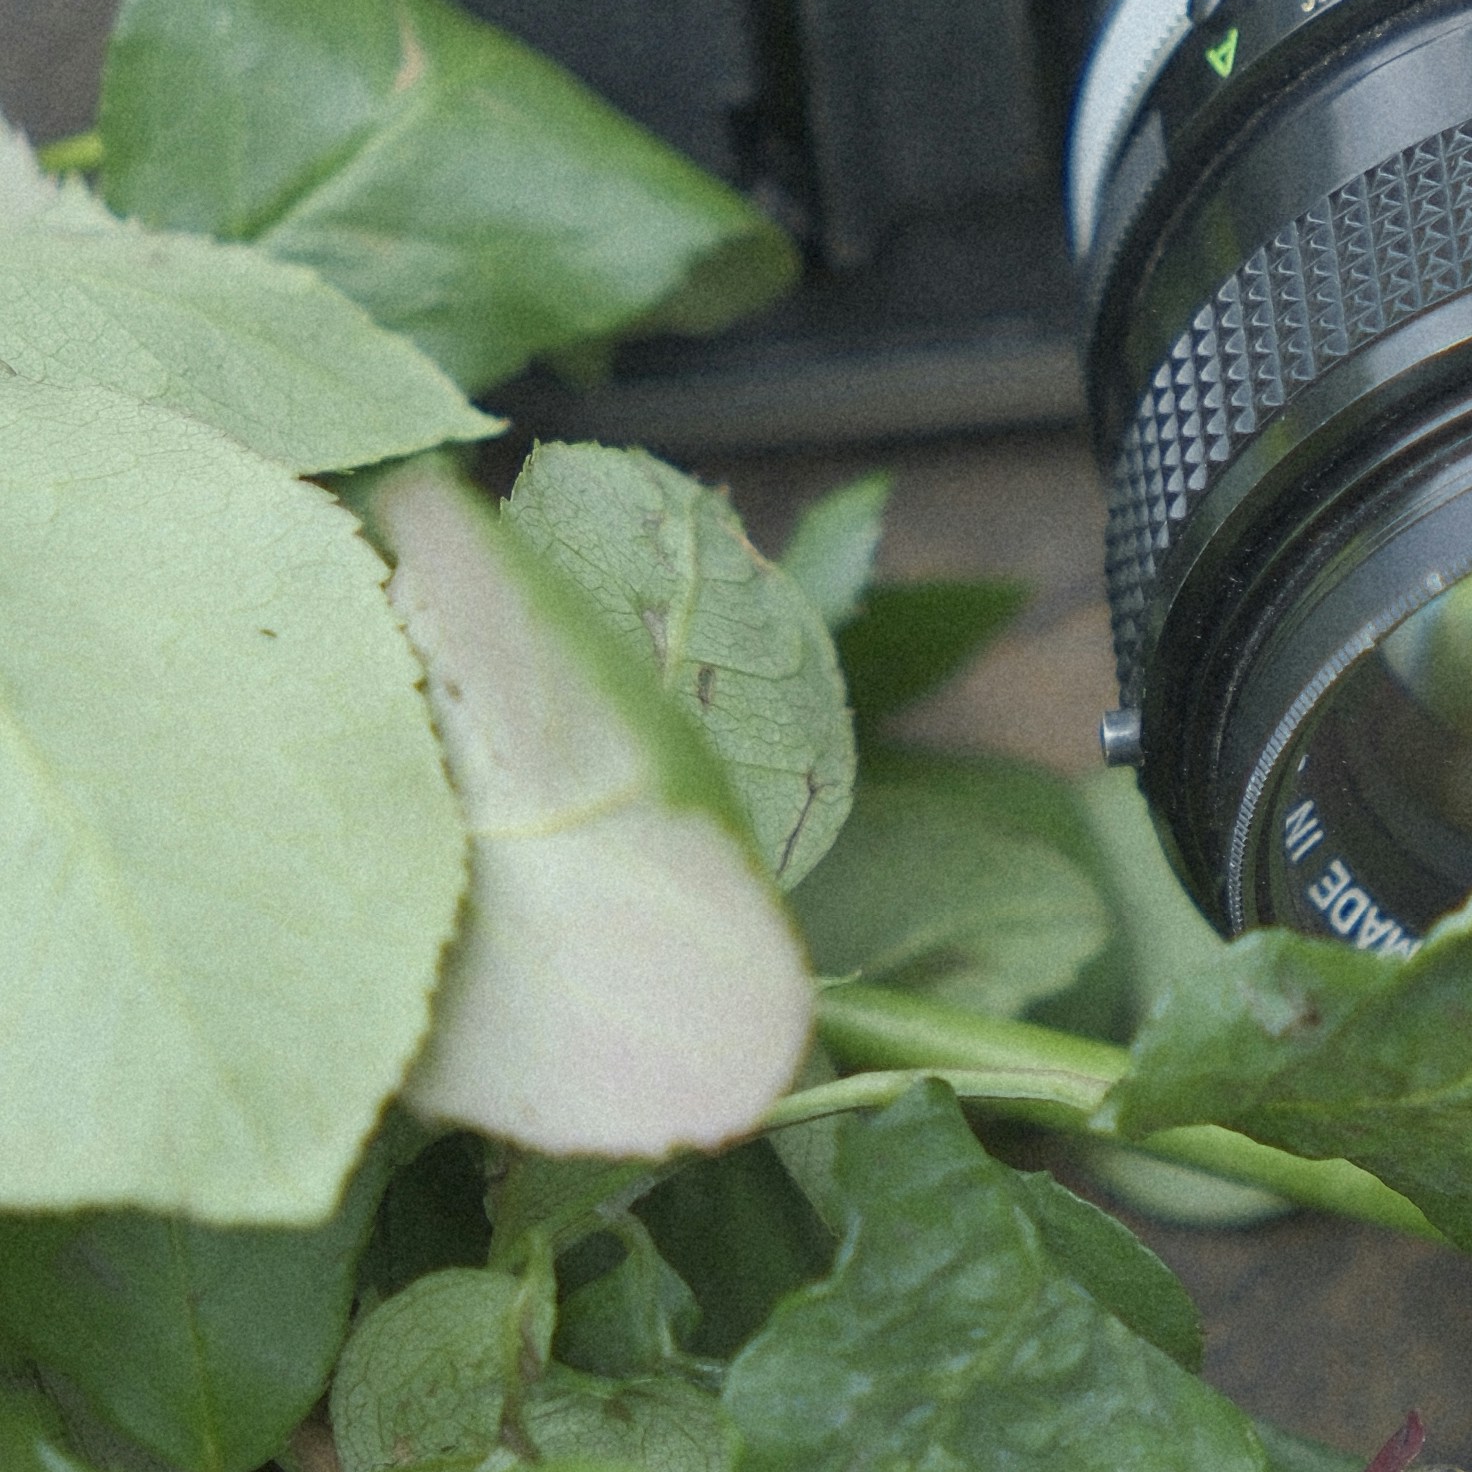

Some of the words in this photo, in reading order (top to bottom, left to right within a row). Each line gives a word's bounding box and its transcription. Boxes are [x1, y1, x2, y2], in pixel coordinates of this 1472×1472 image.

[1206, 27, 1239, 78] A
[1285, 799, 1324, 863] IN
[1308, 859, 1424, 960] MADE
